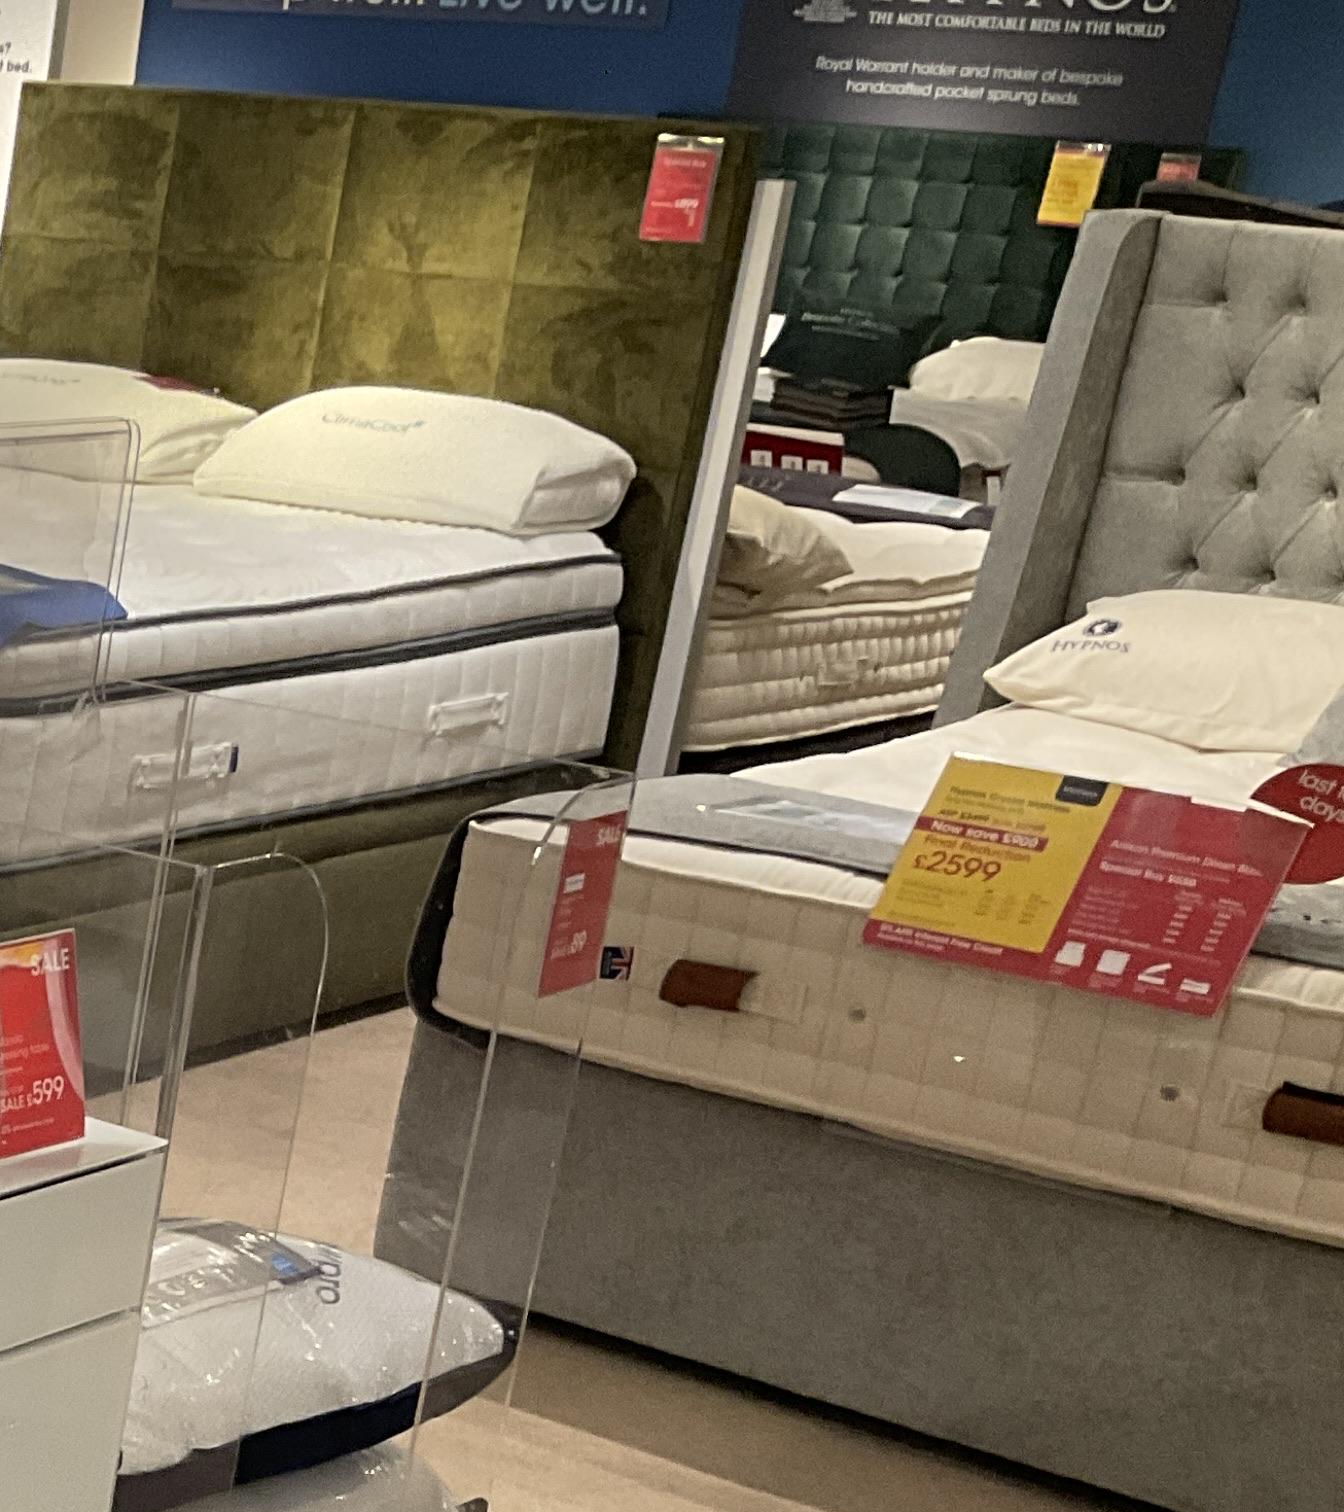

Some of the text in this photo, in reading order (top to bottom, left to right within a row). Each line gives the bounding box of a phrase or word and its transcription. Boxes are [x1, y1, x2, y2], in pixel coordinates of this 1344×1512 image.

[868, 10, 894, 25] THE
[896, 12, 934, 27] MOST
[934, 14, 1026, 32] COMFORTABLE
[1064, 20, 1081, 34] IN
[1084, 21, 1112, 36] THE
[815, 55, 854, 73] Royal
[959, 64, 989, 80] and
[1052, 638, 1132, 653] HYPNOS
[1298, 768, 1338, 796] last
[930, 819, 963, 835] Now
[964, 826, 1000, 842] save
[912, 850, 1003, 882] £2599
[30, 947, 71, 977] SALE
[26, 1075, 65, 1108] £599
